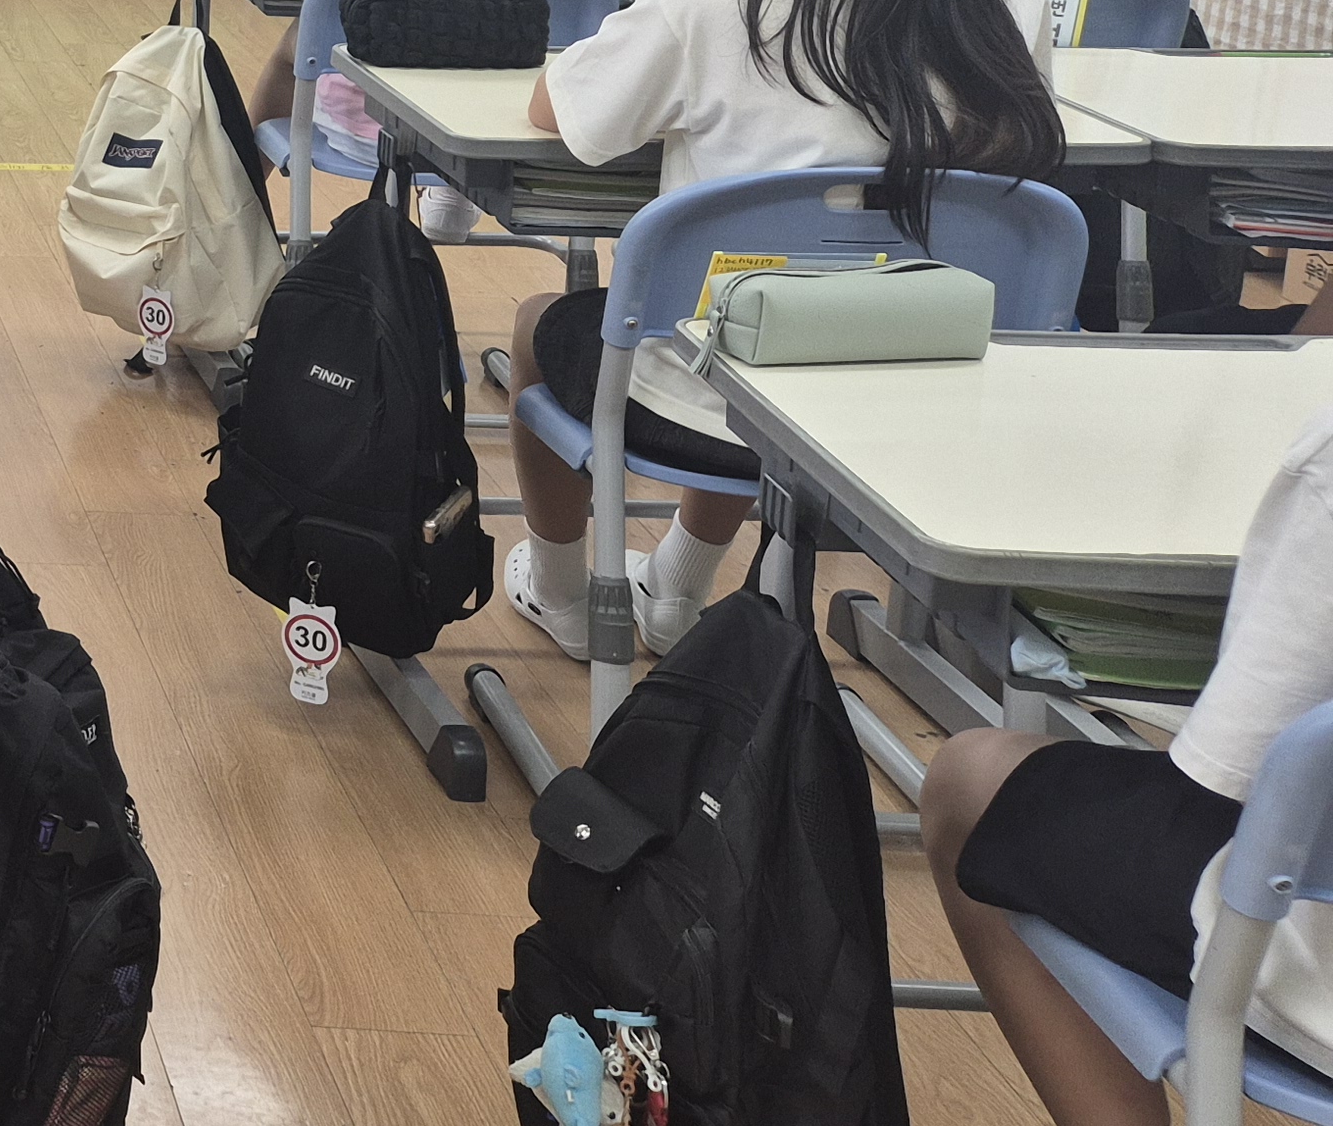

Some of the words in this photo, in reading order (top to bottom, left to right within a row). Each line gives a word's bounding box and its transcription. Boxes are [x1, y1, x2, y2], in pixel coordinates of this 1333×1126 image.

[145, 306, 166, 325] 30
[310, 364, 356, 390] FINDIT
[294, 625, 327, 652] 30
